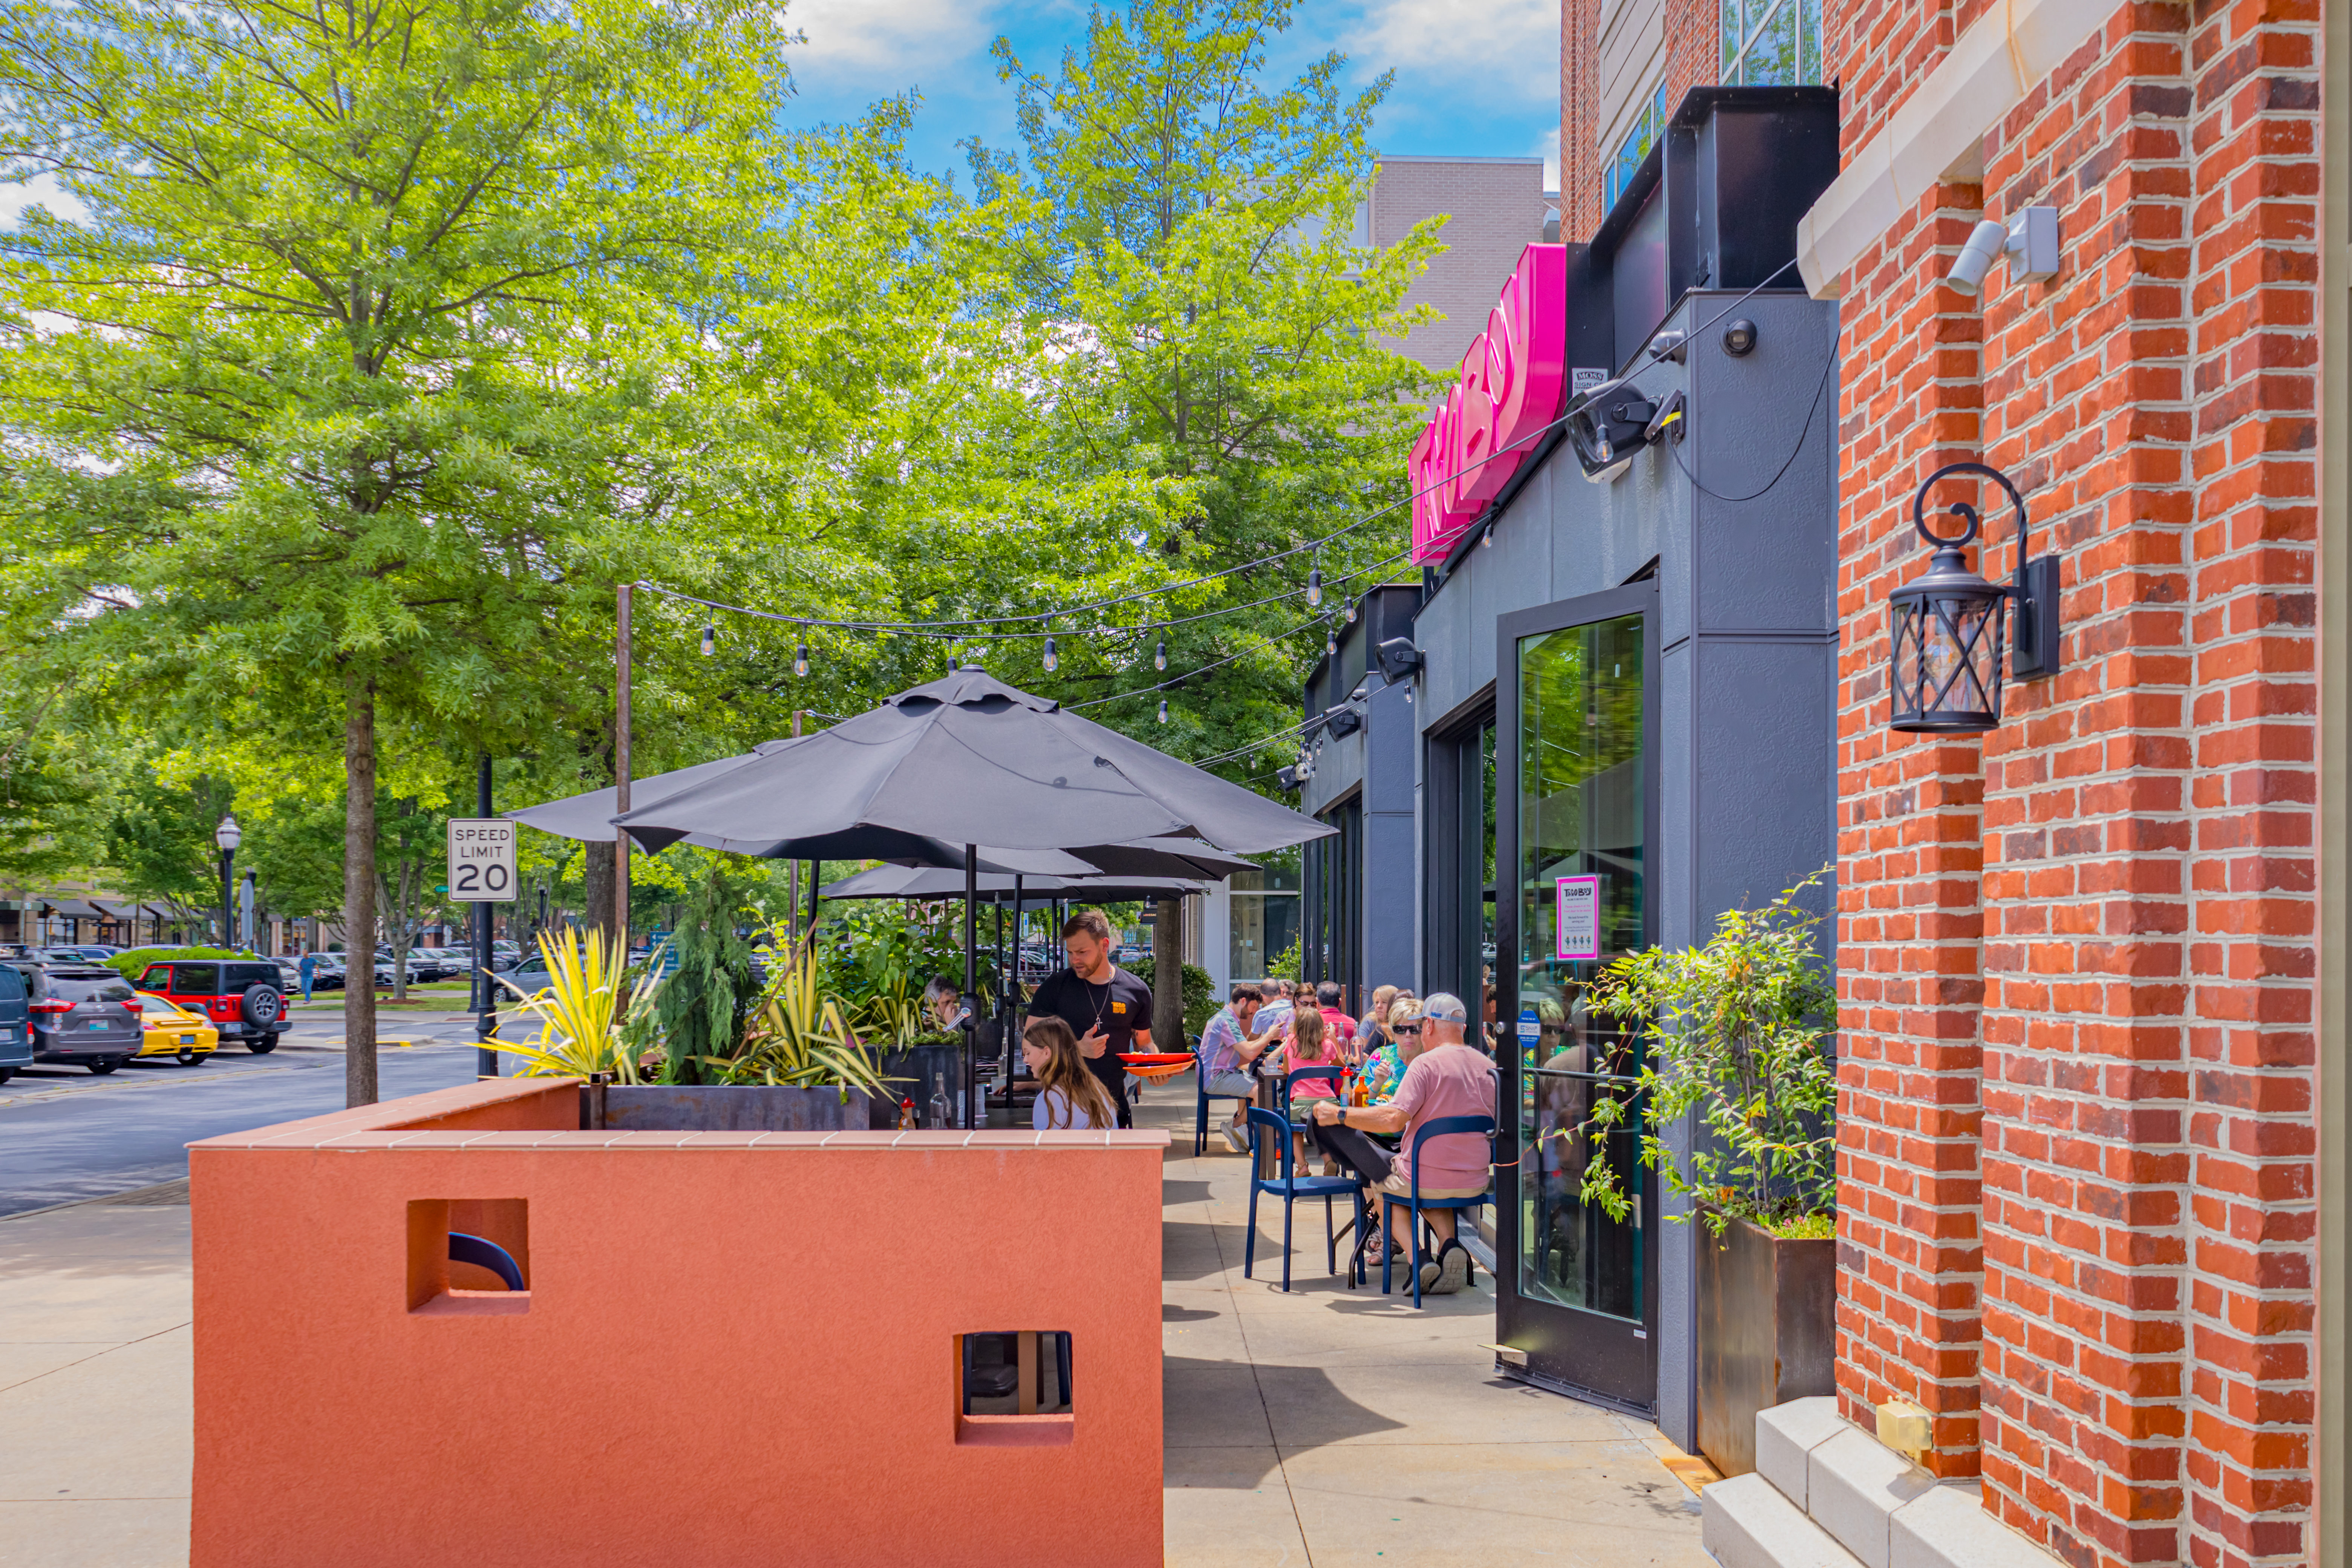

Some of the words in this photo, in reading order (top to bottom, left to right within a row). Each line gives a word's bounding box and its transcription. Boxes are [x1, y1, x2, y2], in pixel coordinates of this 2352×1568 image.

[1578, 372, 1602, 380] MOSS
[1408, 383, 1468, 566] TACO
[1460, 242, 1566, 501] BOY
[455, 830, 509, 841] SPEED
[461, 846, 504, 858] LIMIT
[456, 864, 508, 891] 20
[1564, 888, 1577, 897] TACO
[1578, 887, 1591, 896] BOY
